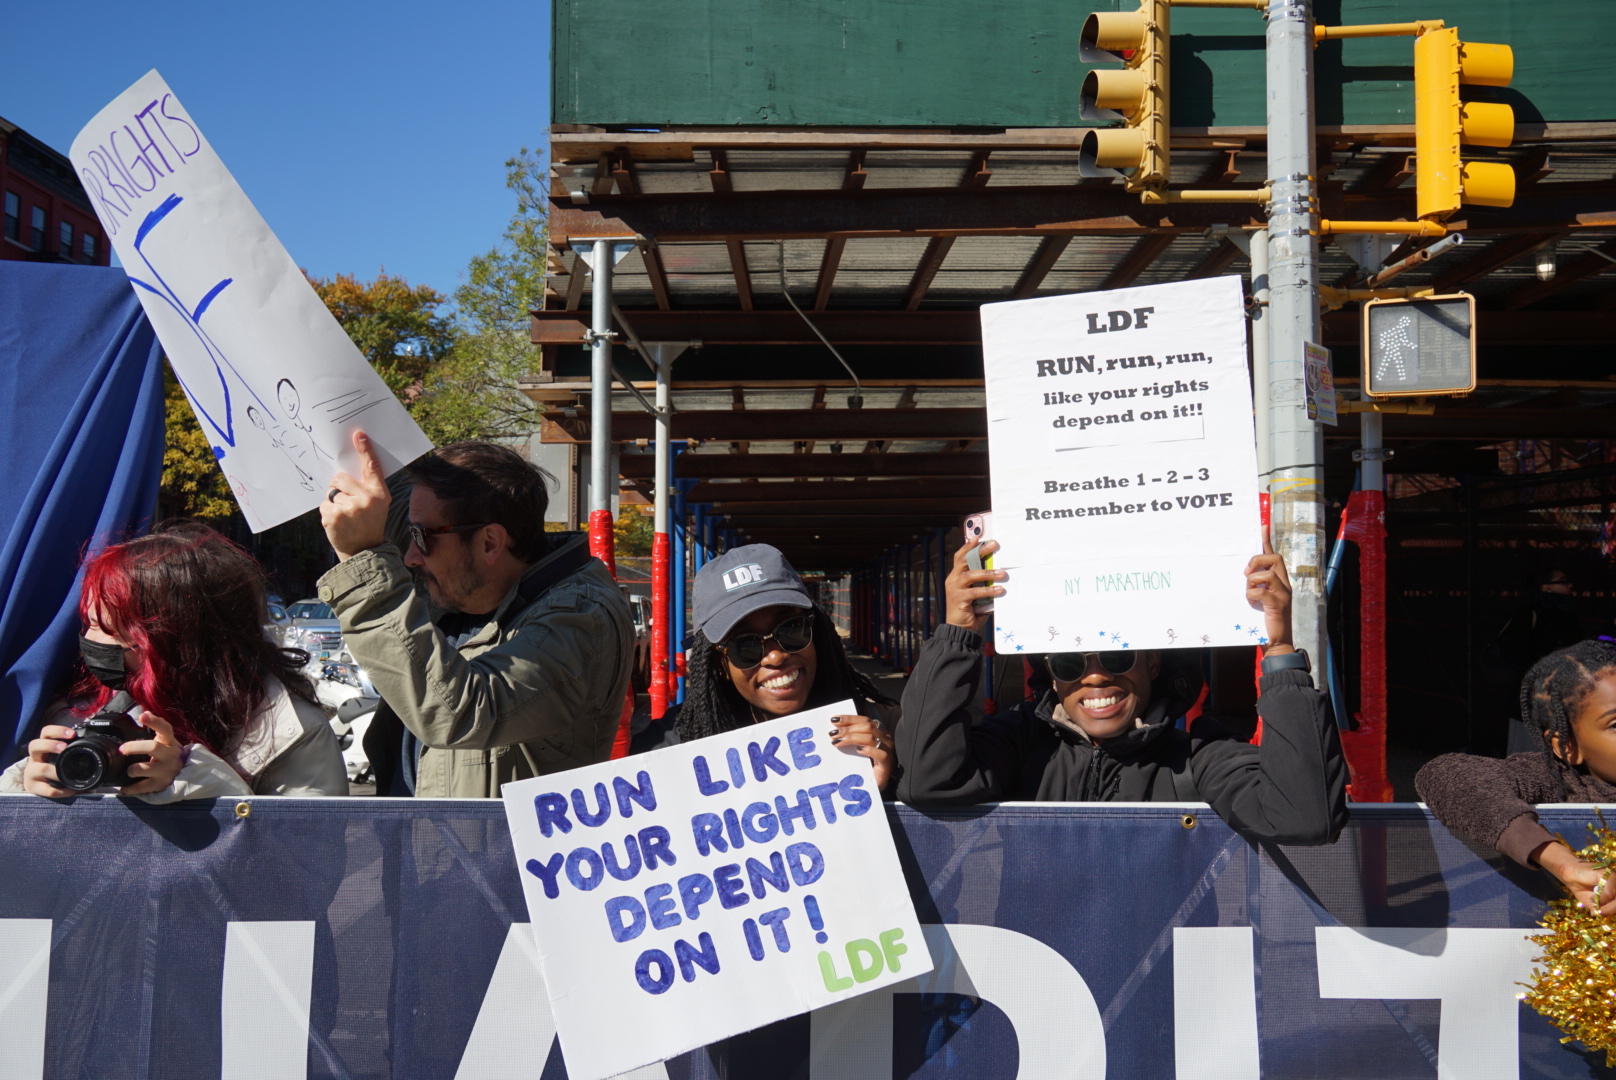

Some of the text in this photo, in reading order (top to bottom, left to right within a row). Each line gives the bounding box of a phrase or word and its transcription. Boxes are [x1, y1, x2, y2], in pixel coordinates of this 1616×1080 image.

[1087, 306, 1155, 335] LDF
[1037, 352, 1213, 378] RUN, run, run,
[1043, 378, 1210, 406] like your rights
[1052, 402, 1203, 430] depend on it!!
[1043, 475, 1130, 494] Breathe
[1025, 492, 1234, 521] Remember to VOTE
[722, 564, 764, 590] LDF
[1064, 571, 1172, 596] NY MARATHON
[534, 727, 822, 838] RUN LIKE
[526, 773, 872, 899] YOUR RIGHTS
[604, 841, 825, 943] DEPEND
[635, 931, 720, 995] ON
[817, 927, 908, 993] LDF
